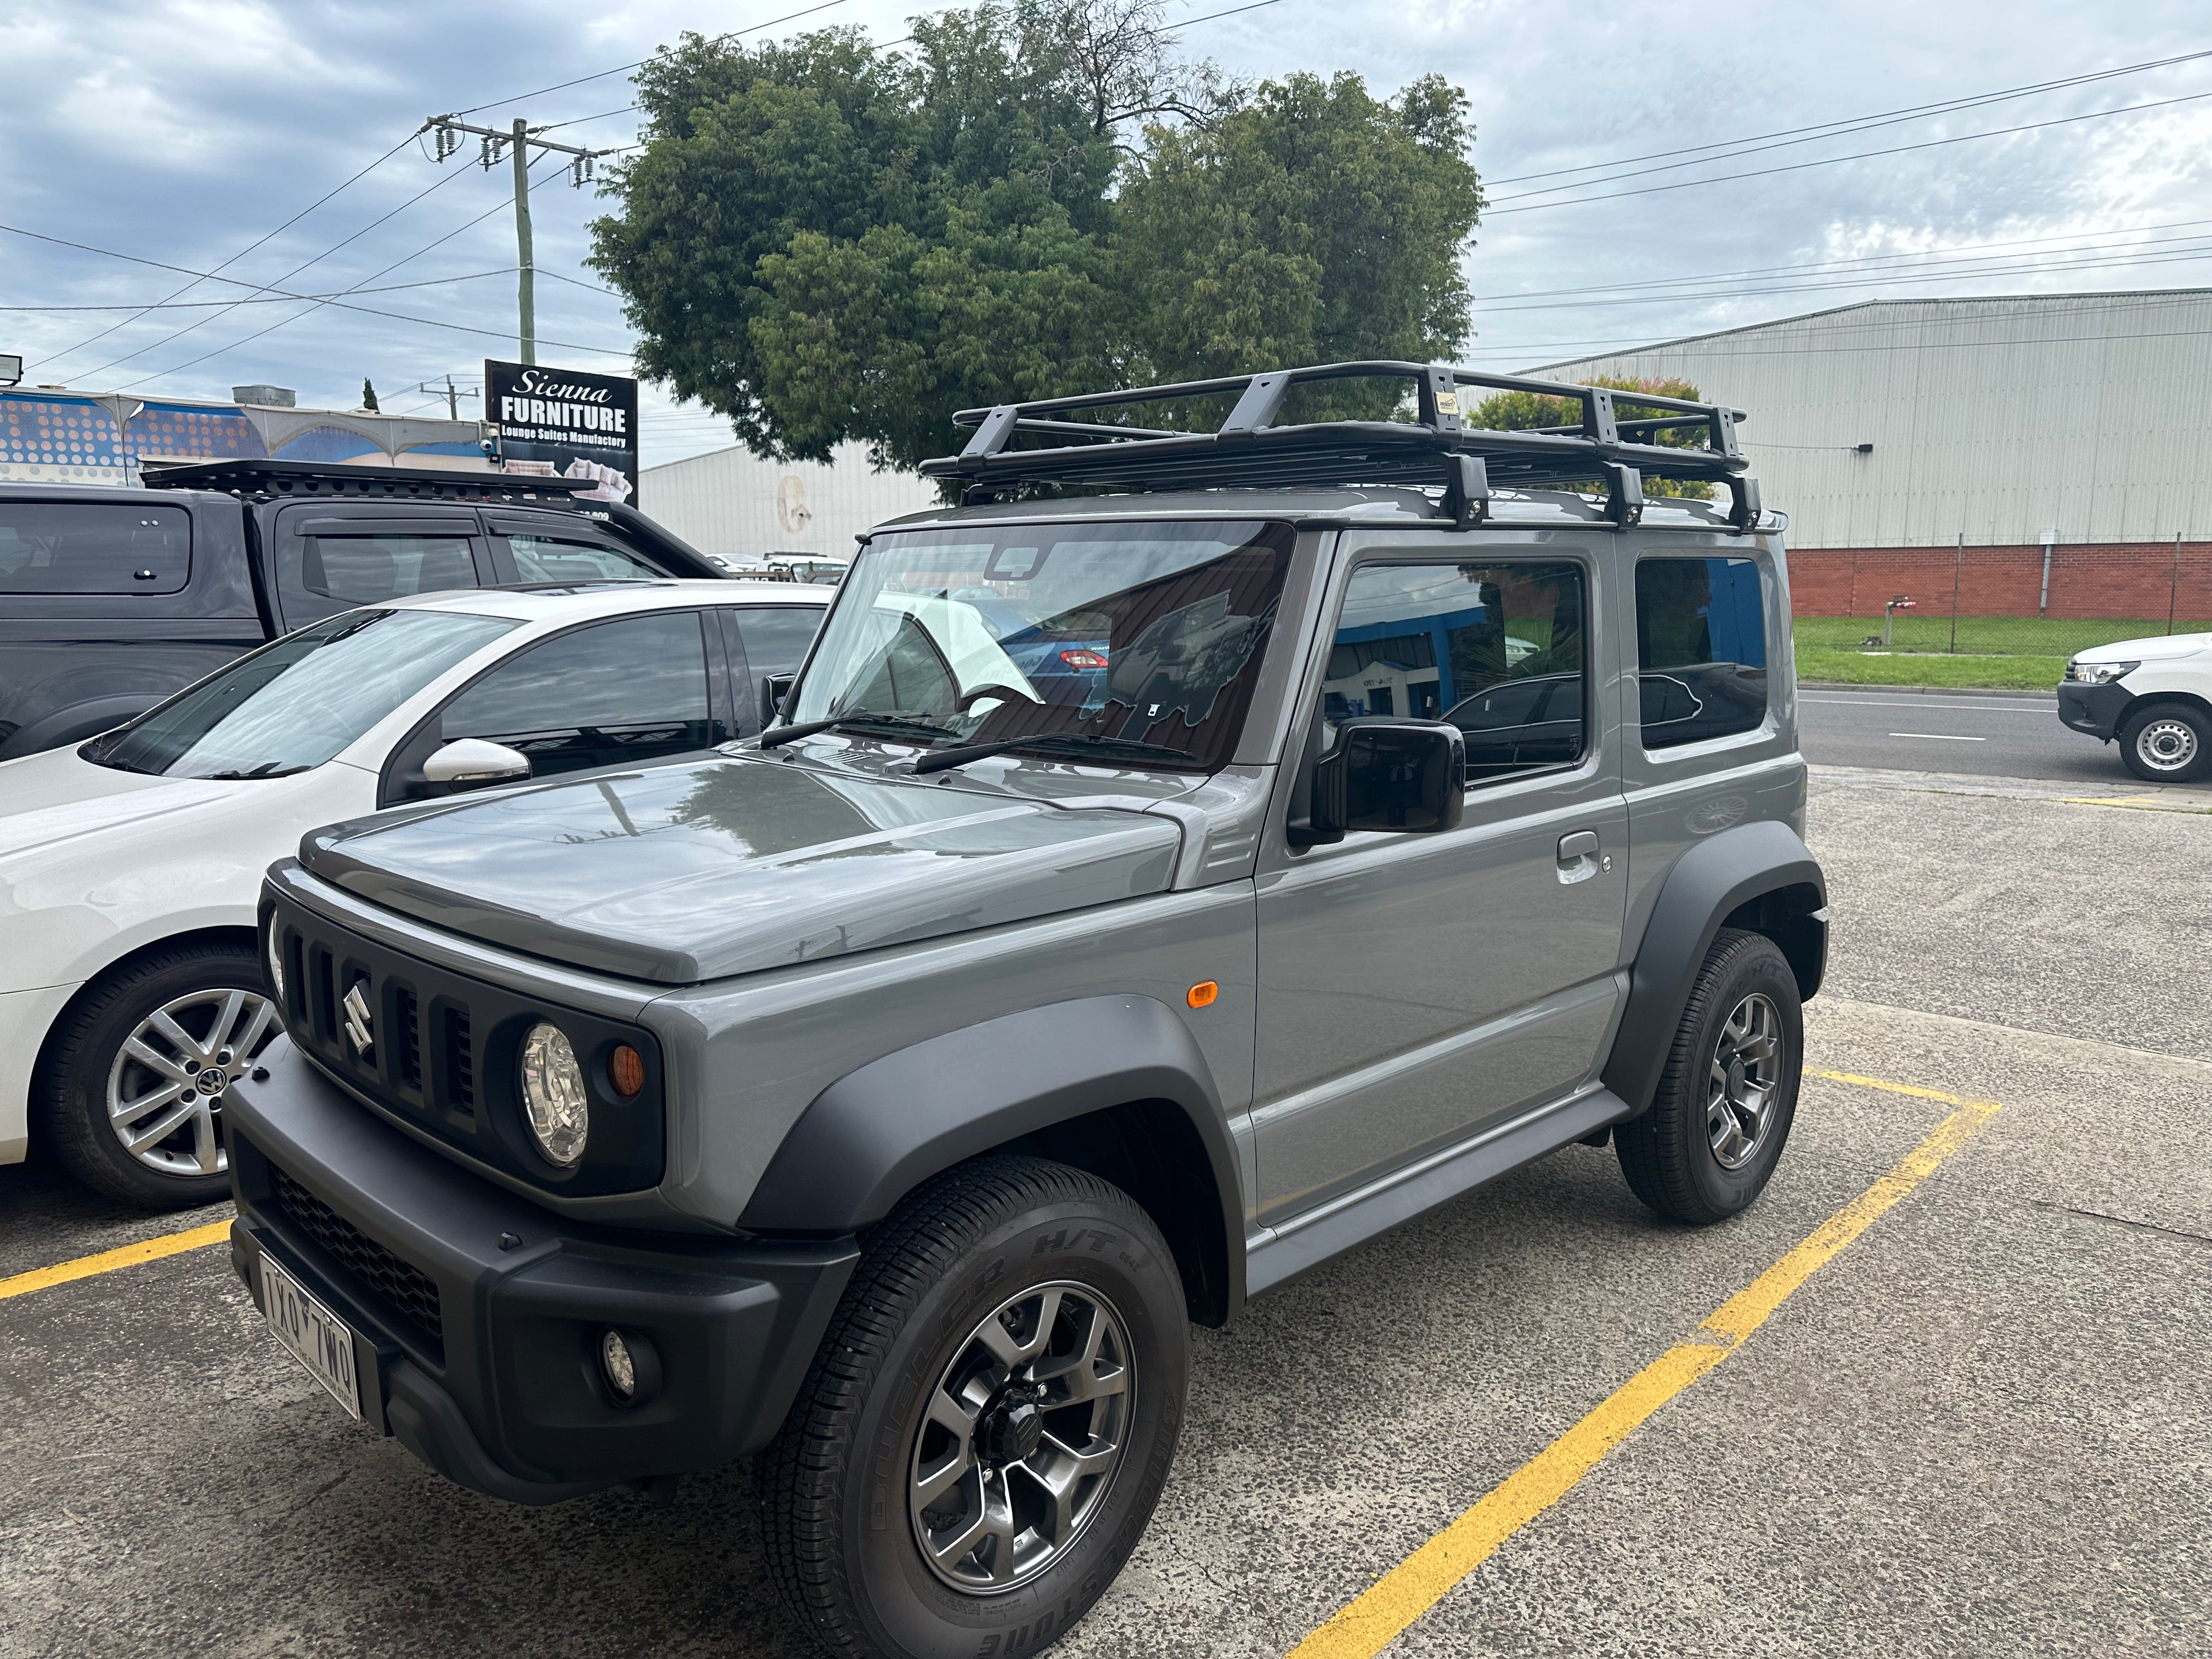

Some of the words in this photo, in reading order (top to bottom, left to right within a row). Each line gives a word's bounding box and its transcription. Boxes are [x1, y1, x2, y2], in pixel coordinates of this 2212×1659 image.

[512, 370, 613, 403] Sienna
[501, 396, 626, 433] FURNITURE
[501, 424, 536, 439] Lounge
[538, 428, 568, 442] Suites
[569, 431, 626, 448] Manufactory
[1031, 1228, 1116, 1259] H/T
[298, 1348, 309, 1363] THE
[337, 1386, 353, 1410] STATE
